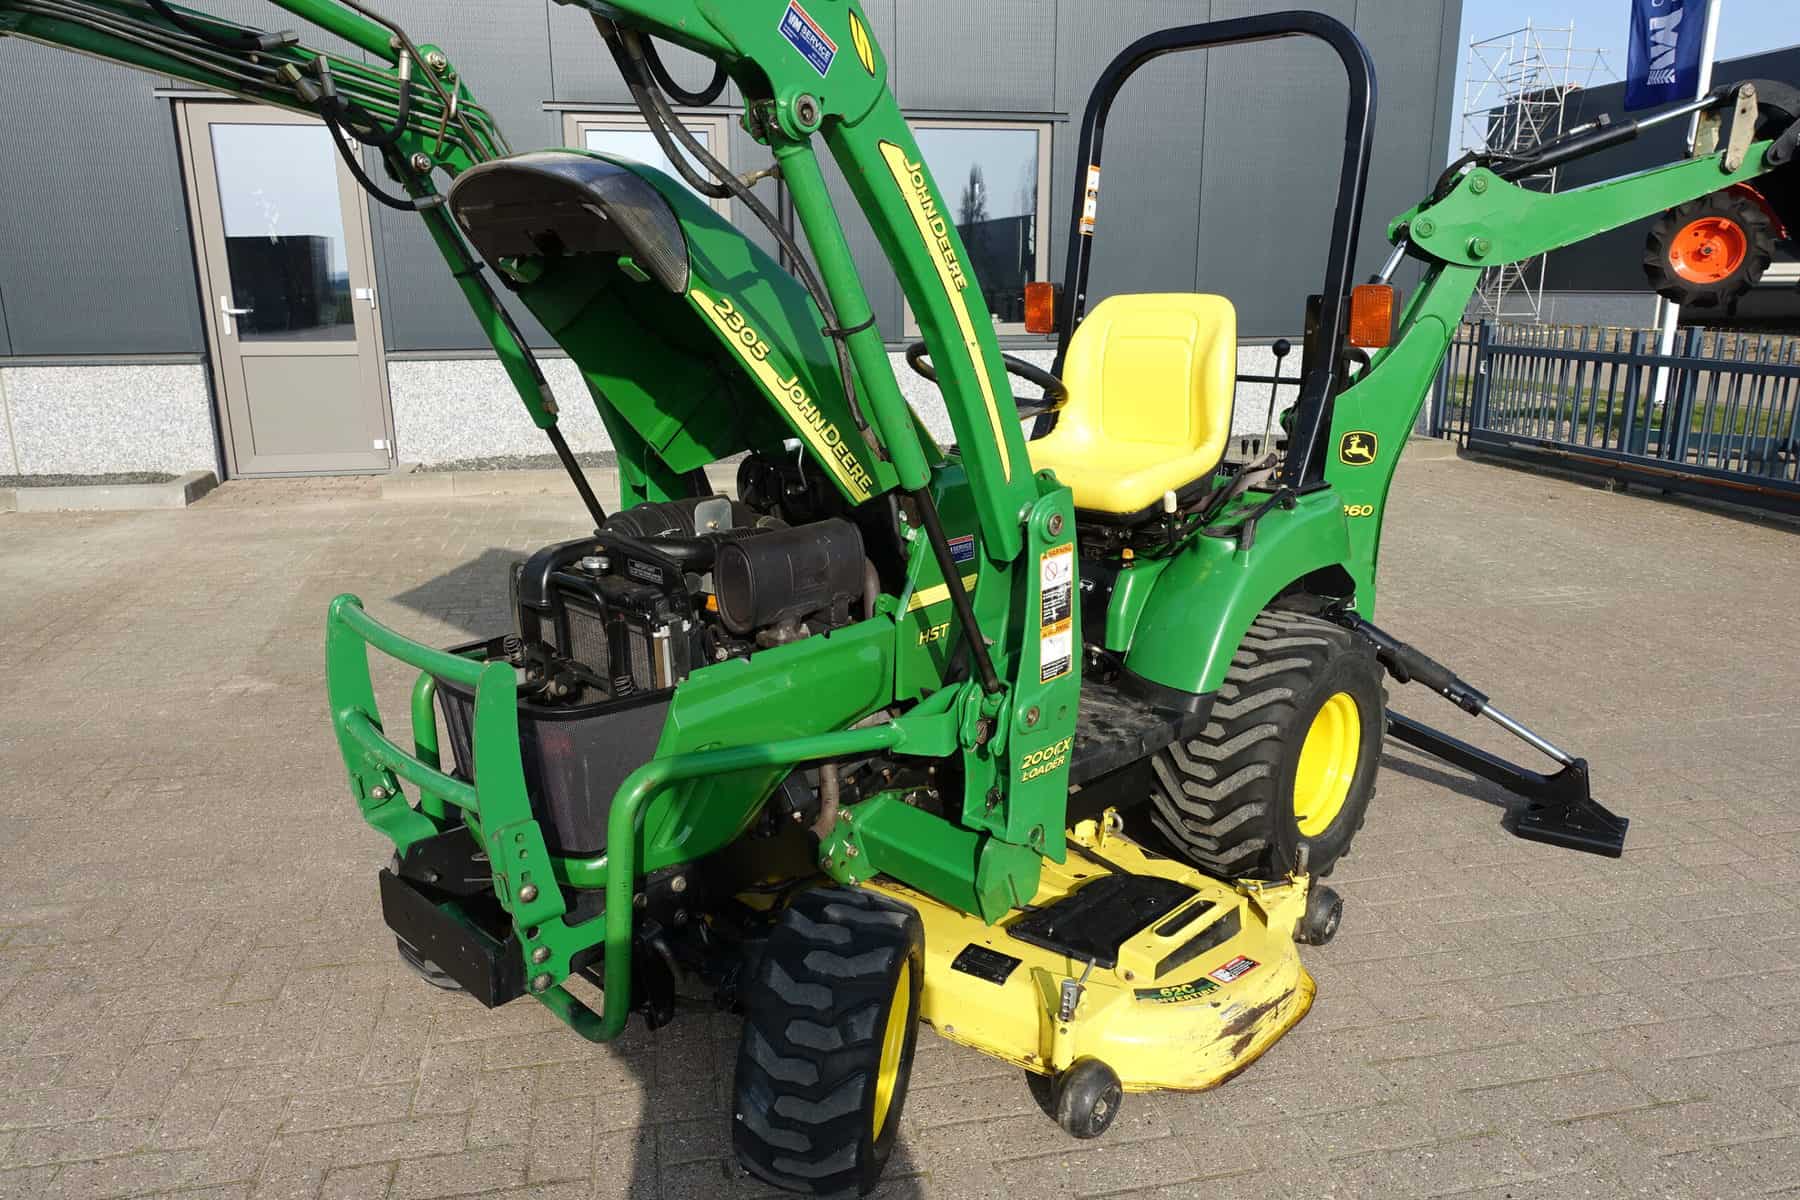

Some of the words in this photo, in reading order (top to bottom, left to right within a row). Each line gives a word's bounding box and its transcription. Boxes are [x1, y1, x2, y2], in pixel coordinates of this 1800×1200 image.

[801, 24, 832, 60] SERVICE
[903, 158, 937, 220] JOHN
[928, 216, 969, 292] DEERE
[713, 298, 770, 362] 2305
[776, 375, 826, 432] JOHN
[818, 423, 874, 494] DEERE
[917, 622, 951, 646] HST
[1021, 736, 1074, 770] 200CX
[1021, 755, 1066, 782] LOADER
[1160, 984, 1196, 998] 62C
